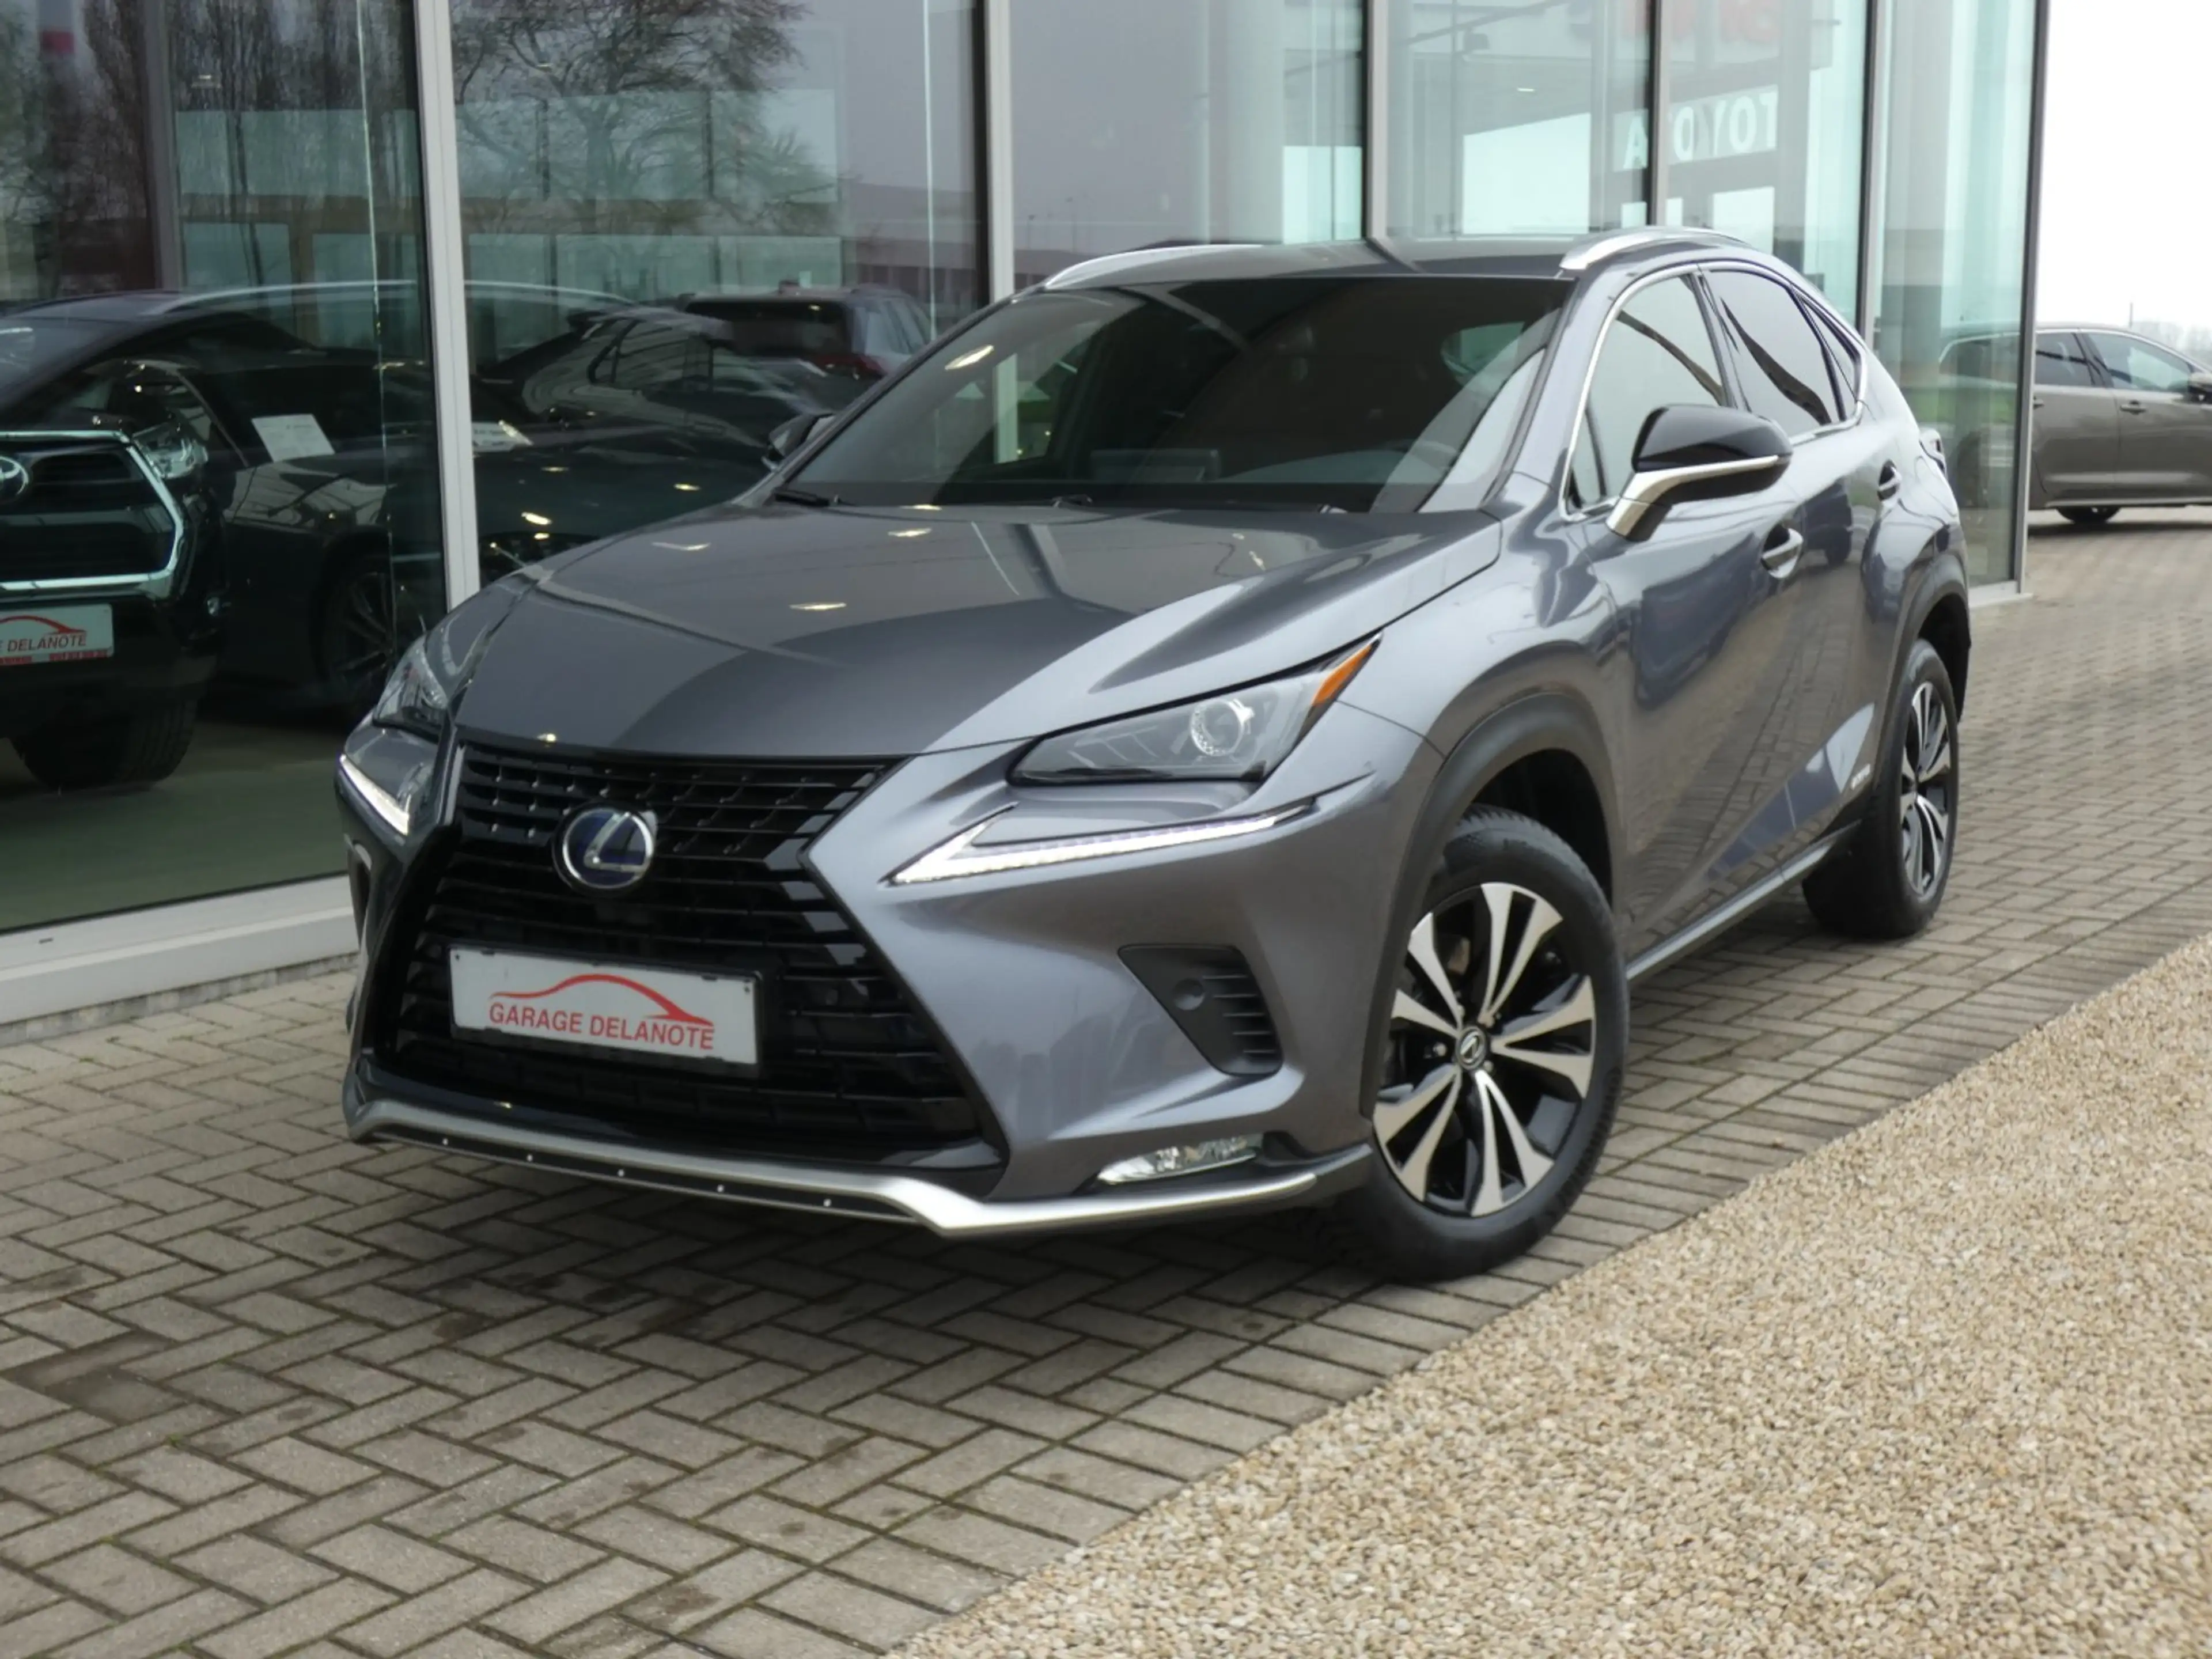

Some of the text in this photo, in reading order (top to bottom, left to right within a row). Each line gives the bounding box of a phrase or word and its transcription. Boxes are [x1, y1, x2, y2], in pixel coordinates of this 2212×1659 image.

[7, 634, 86, 652] DELANOTE
[490, 1003, 714, 1050] GARAGE DELANOTE
